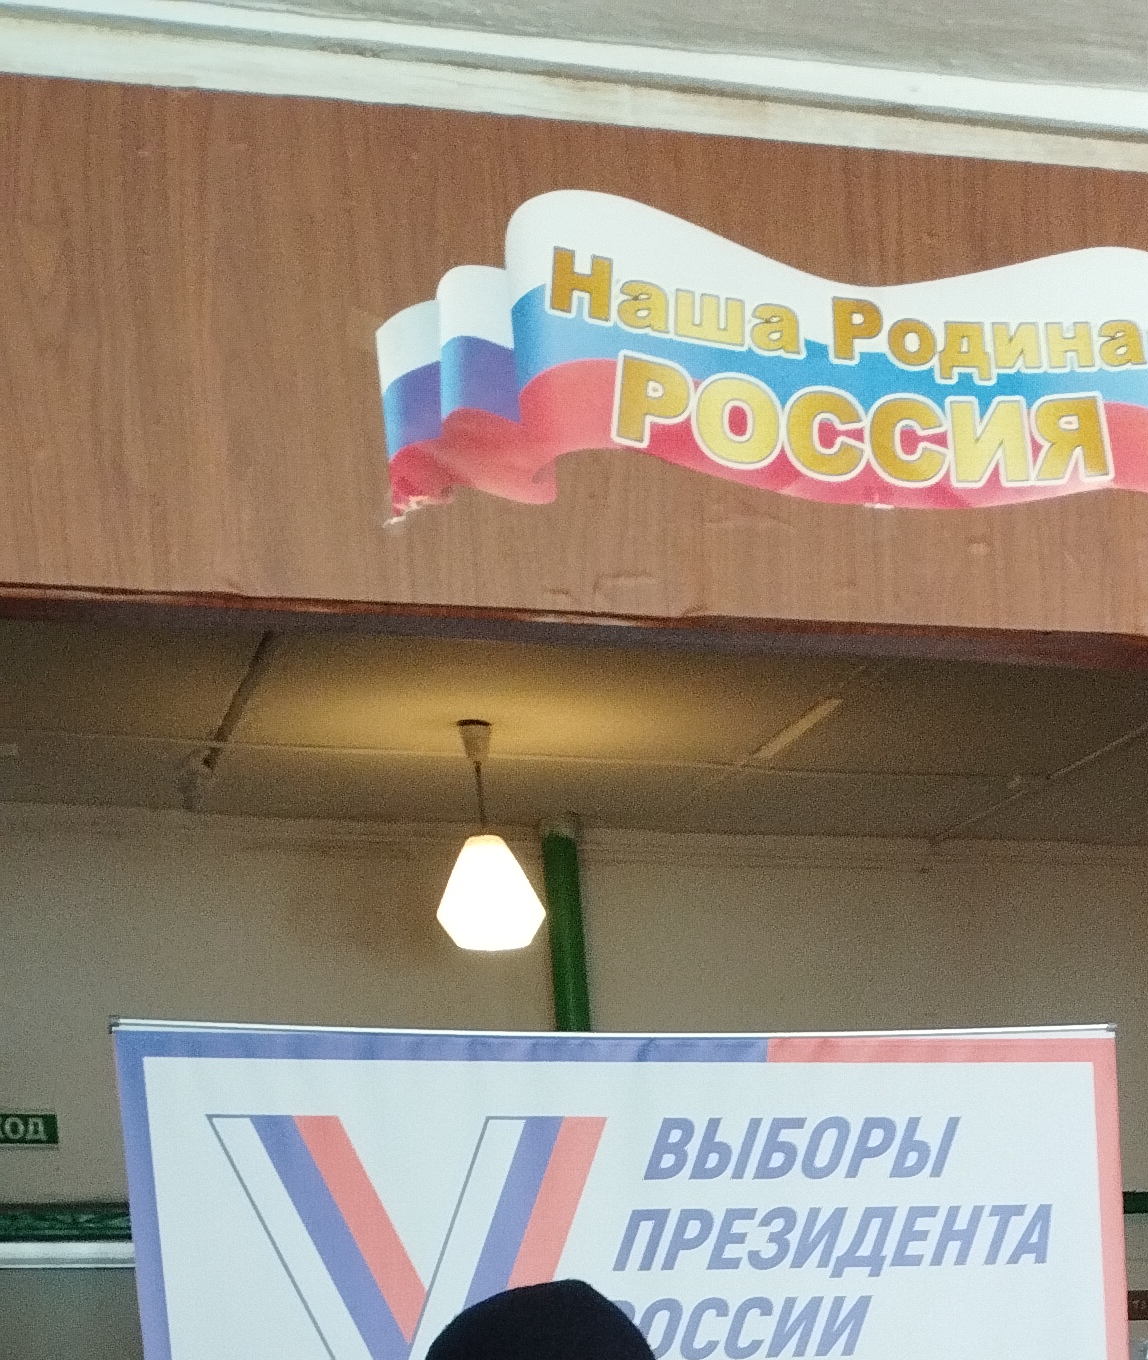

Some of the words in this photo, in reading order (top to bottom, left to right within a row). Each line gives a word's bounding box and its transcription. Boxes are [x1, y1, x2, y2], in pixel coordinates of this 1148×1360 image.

[549, 245, 802, 355] Наша
[614, 356, 1112, 485] РОССИЯ
[643, 1115, 962, 1181] ВЫБОРЫ
[612, 1203, 1054, 1278] ПРЕЗИДЕНТА
